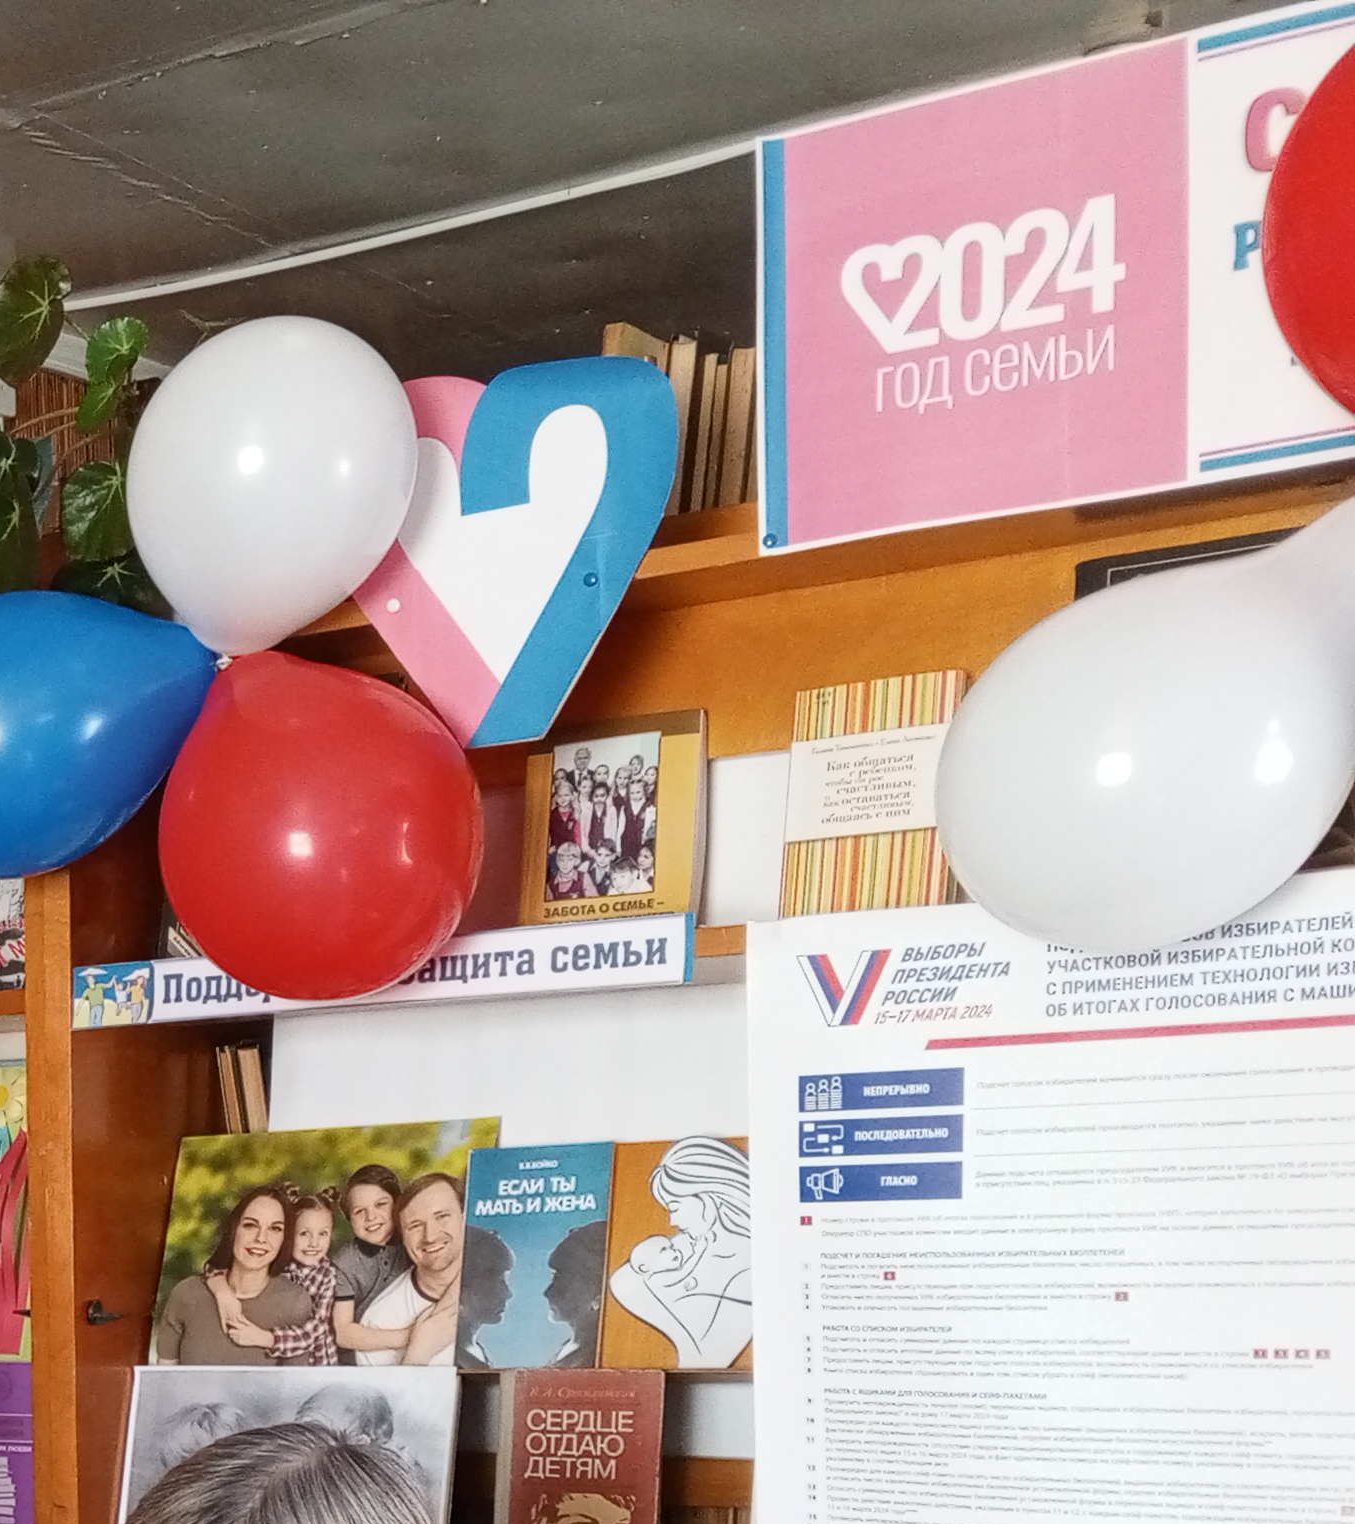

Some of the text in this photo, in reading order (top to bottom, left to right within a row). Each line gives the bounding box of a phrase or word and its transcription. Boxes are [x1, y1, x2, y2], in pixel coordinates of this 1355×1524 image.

[847, 193, 1127, 355] 2024
[827, 754, 914, 772] Как общаться
[543, 899, 657, 919] ЗАБОТА О СЕМЬЕ
[1220, 911, 1354, 939] ИЗБИРАТЕЛЕЙ
[549, 935, 669, 975] семьи
[901, 942, 987, 963] ВЫБОРЫ
[1047, 949, 1163, 975] УЧАСТКОВОЙ
[1167, 937, 1326, 965] ИЗБИРАТЕЛЬНОЙ
[890, 961, 1012, 985] ПРЕЗИДЕНТА
[1046, 982, 1057, 996] С
[1061, 972, 1193, 995] ПРИМЕНЕНИЕМ
[1200, 962, 1321, 986] ТЕХНОЛОГИИ
[880, 986, 960, 1007] РОССИИ
[1046, 1001, 1067, 1017] ОБ
[1072, 998, 1140, 1016] ИТОГАХ
[1145, 988, 1277, 1011] ГОЛОСОВАНИЯ
[1283, 987, 1295, 1001] С
[911, 1006, 959, 1023] МАРТА
[960, 1003, 995, 1020] 2024
[863, 1082, 931, 1098] НЕПРЕРЫВНО
[853, 1126, 949, 1143] ПОСЛЕДОВАТЕЛЬНО
[497, 1176, 576, 1196] ЕСЛИ ТЫ
[880, 1174, 919, 1188] ГЛАСНО
[475, 1194, 597, 1216] МАТЬ И ЖЕНА
[525, 1408, 635, 1436] СЕРДЦЕ
[524, 1433, 625, 1458] ОТДАЮ
[524, 1455, 617, 1482] ДЕТЯМ
